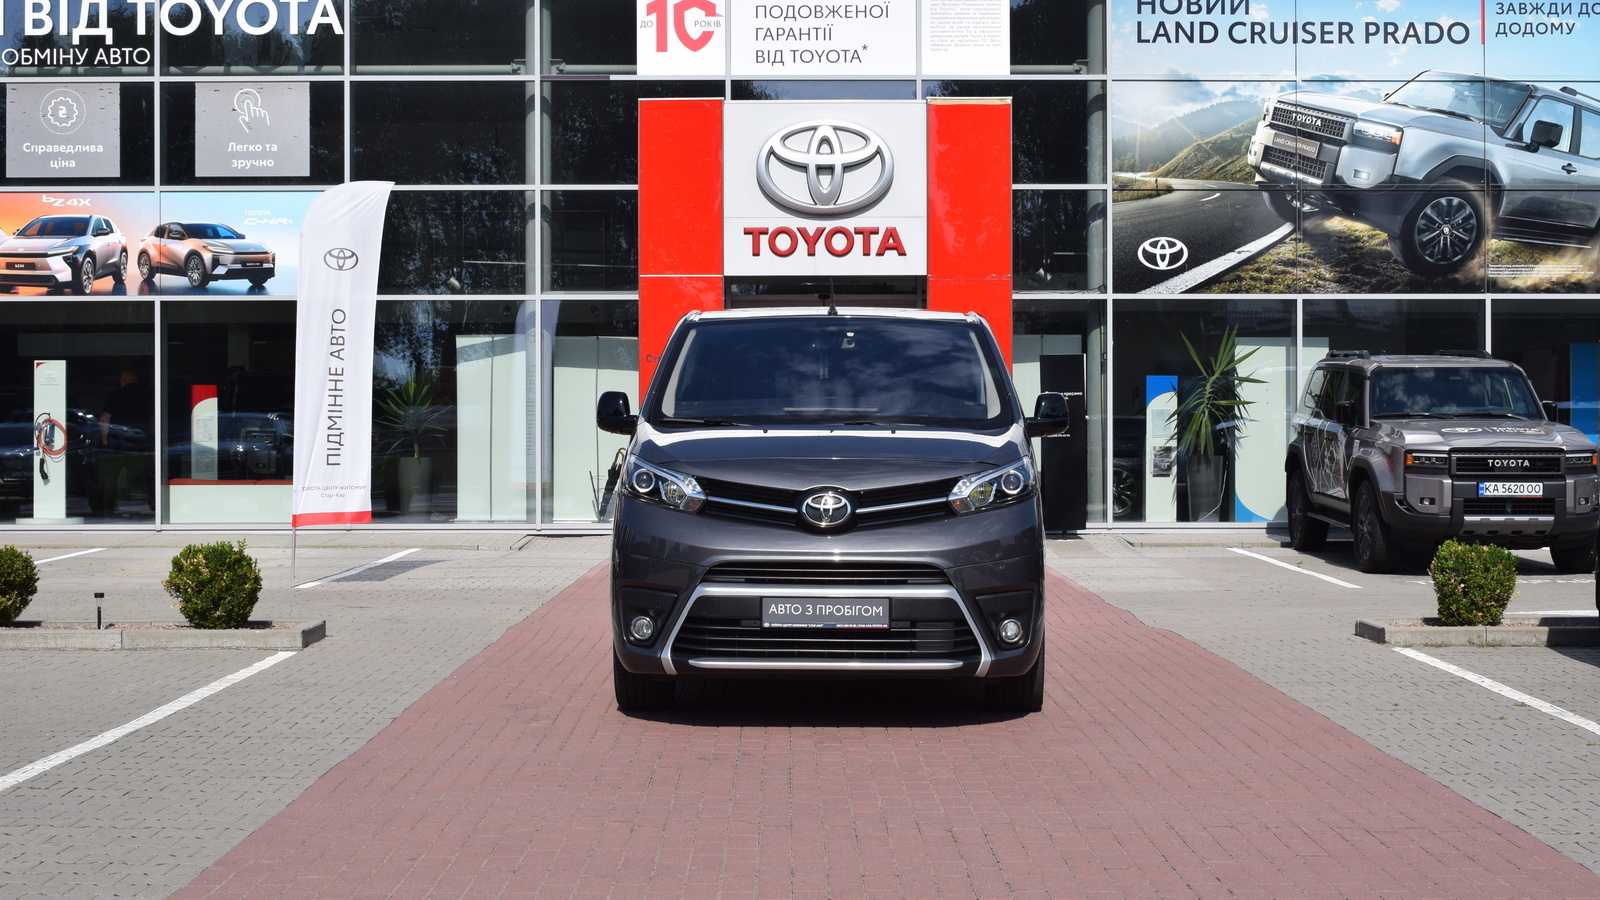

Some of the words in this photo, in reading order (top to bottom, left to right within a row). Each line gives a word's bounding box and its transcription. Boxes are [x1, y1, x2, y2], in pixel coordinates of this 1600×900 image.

[755, 3, 890, 23] ПОДОВЖЕНОЇ
[1495, 2, 1572, 18] ЗАВЖДИ
[25, 0, 113, 45] ВІД
[136, 0, 344, 36] TOYOTA
[640, 20, 654, 29] ДО
[694, 20, 722, 28] РОКІВ
[1495, 22, 1576, 37] ДОДОМУ
[755, 24, 833, 42] ГАРАНТІЇ
[1136, 21, 1219, 43] LAND
[1228, 21, 1356, 44] CRUISER
[1365, 22, 1470, 44] PRADO
[1, 48, 87, 65] ОБМІНУ
[94, 48, 150, 65] АВТО
[755, 50, 785, 66] ВІД
[1292, 113, 1322, 126] TOYOTA
[23, 142, 104, 155] Справедлива
[228, 142, 262, 153] Легко
[265, 143, 278, 153] та
[50, 158, 76, 170] ціна
[231, 158, 275, 170] зручно
[42, 194, 92, 207] bZ4X
[743, 226, 907, 257] TOYOTA
[329, 308, 347, 361] АВТО
[326, 367, 344, 466] ПІДМІННЕ
[1488, 459, 1530, 467] TOYOTA
[1484, 484, 1499, 494] KA
[1501, 484, 1525, 494] 5620
[768, 604, 802, 615] АВТО
[805, 605, 813, 615] З
[816, 605, 883, 617] ПРОБІГОМ
